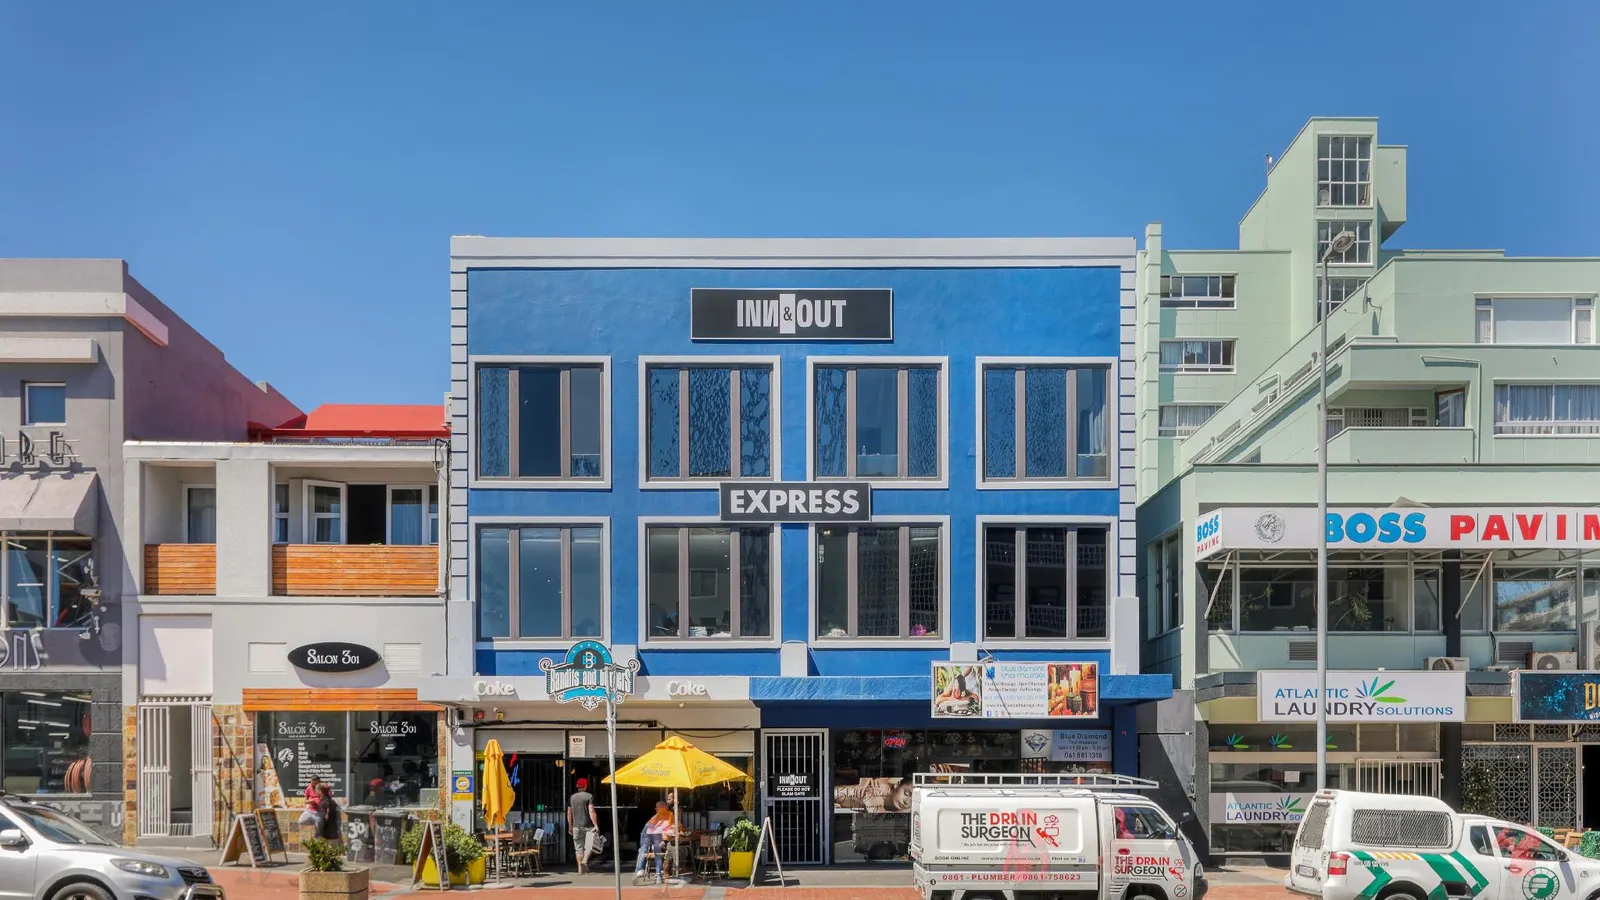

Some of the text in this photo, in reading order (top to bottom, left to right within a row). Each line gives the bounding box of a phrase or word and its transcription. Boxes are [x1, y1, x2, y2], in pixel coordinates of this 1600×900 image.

[730, 489, 860, 514] EXPRESS
[1196, 514, 1219, 543] BOSS
[1326, 512, 1427, 543] BOSS
[1196, 536, 1220, 555] PAVING
[307, 648, 359, 664] SALON 301
[582, 668, 597, 686] and
[474, 680, 516, 696] Coke
[667, 680, 708, 696] Coke
[1275, 688, 1349, 699] ATLATIC
[1584, 682, 1600, 710] D
[1376, 706, 1453, 716] SOLUTIONS
[310, 721, 325, 734] 301
[401, 721, 417, 734] 301
[885, 738, 906, 746] OPEN
[1060, 732, 1076, 740] Blue
[961, 813, 1037, 825] THE DRAIN
[1227, 811, 1289, 821] LAUNDRY
[961, 826, 1031, 839] SURGEON
[1114, 856, 1170, 866] THE DRAIN
[1114, 865, 1165, 875] SURGEON
